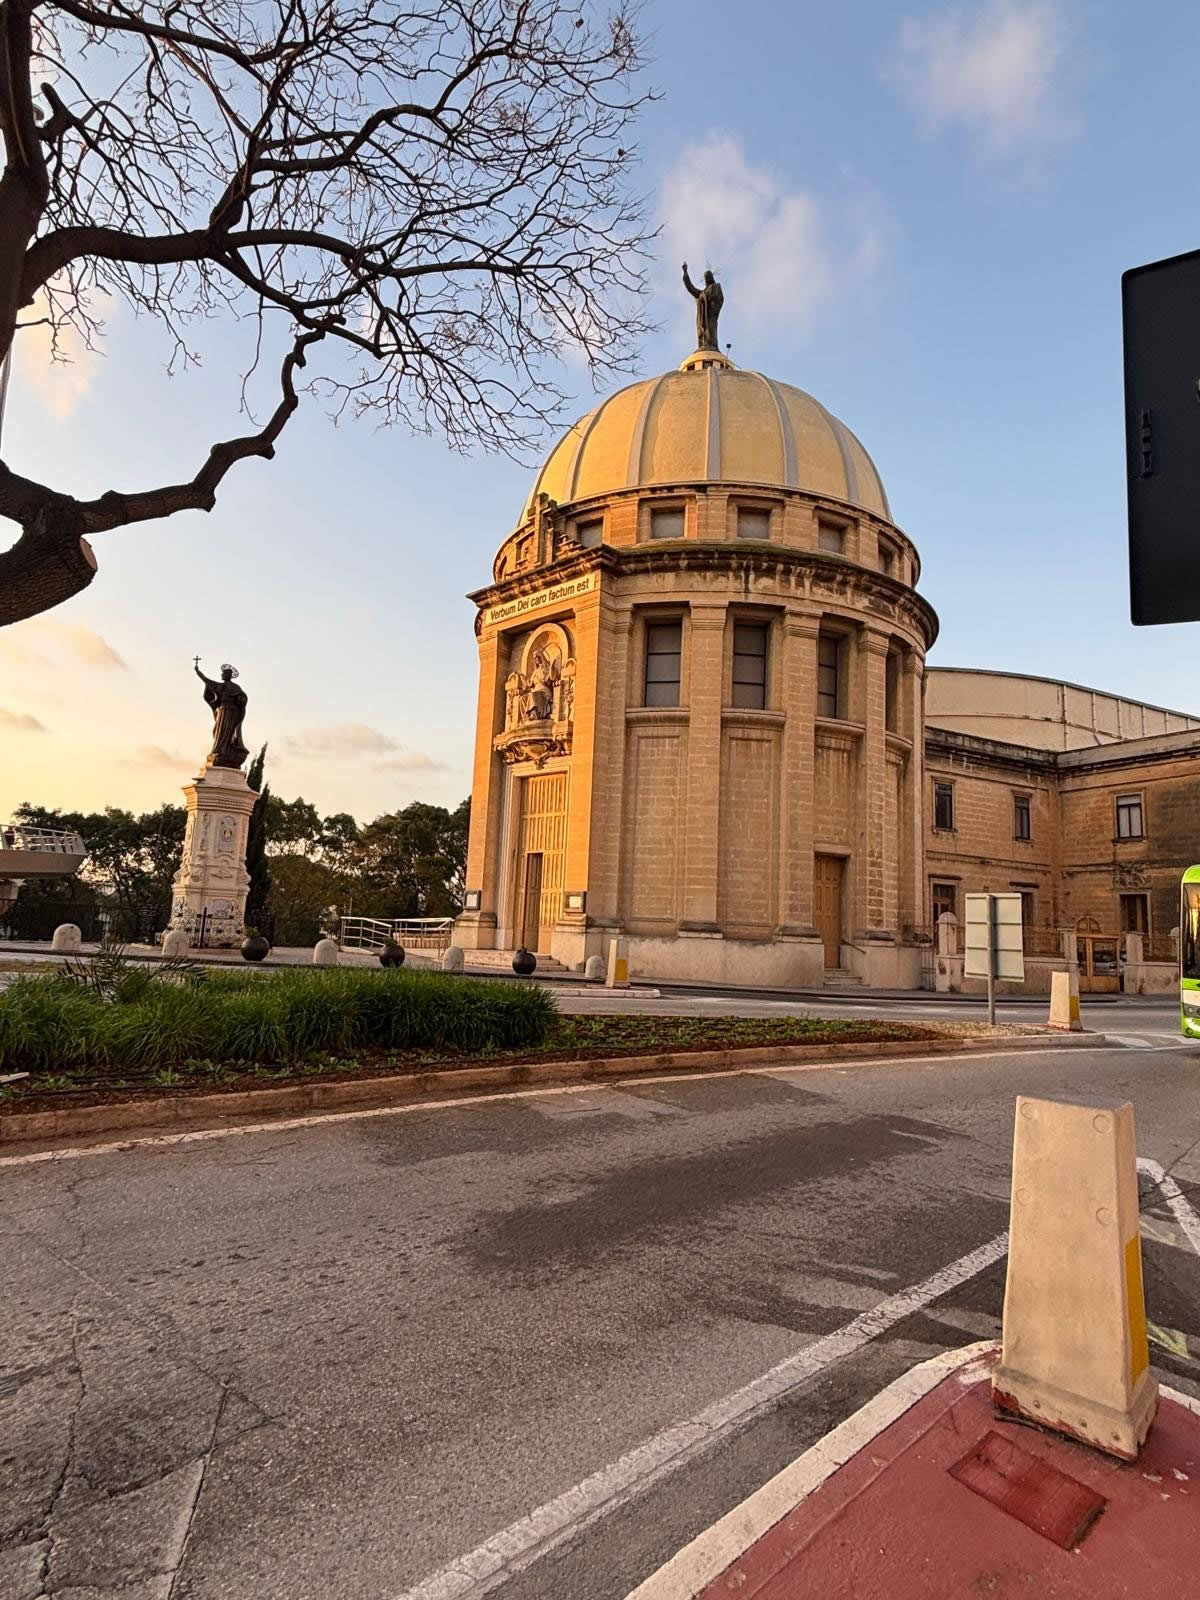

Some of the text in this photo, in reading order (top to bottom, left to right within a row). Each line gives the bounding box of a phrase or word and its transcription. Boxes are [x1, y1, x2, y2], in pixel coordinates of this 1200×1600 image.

[491, 578, 589, 620] Verbum Dei caro factum est
